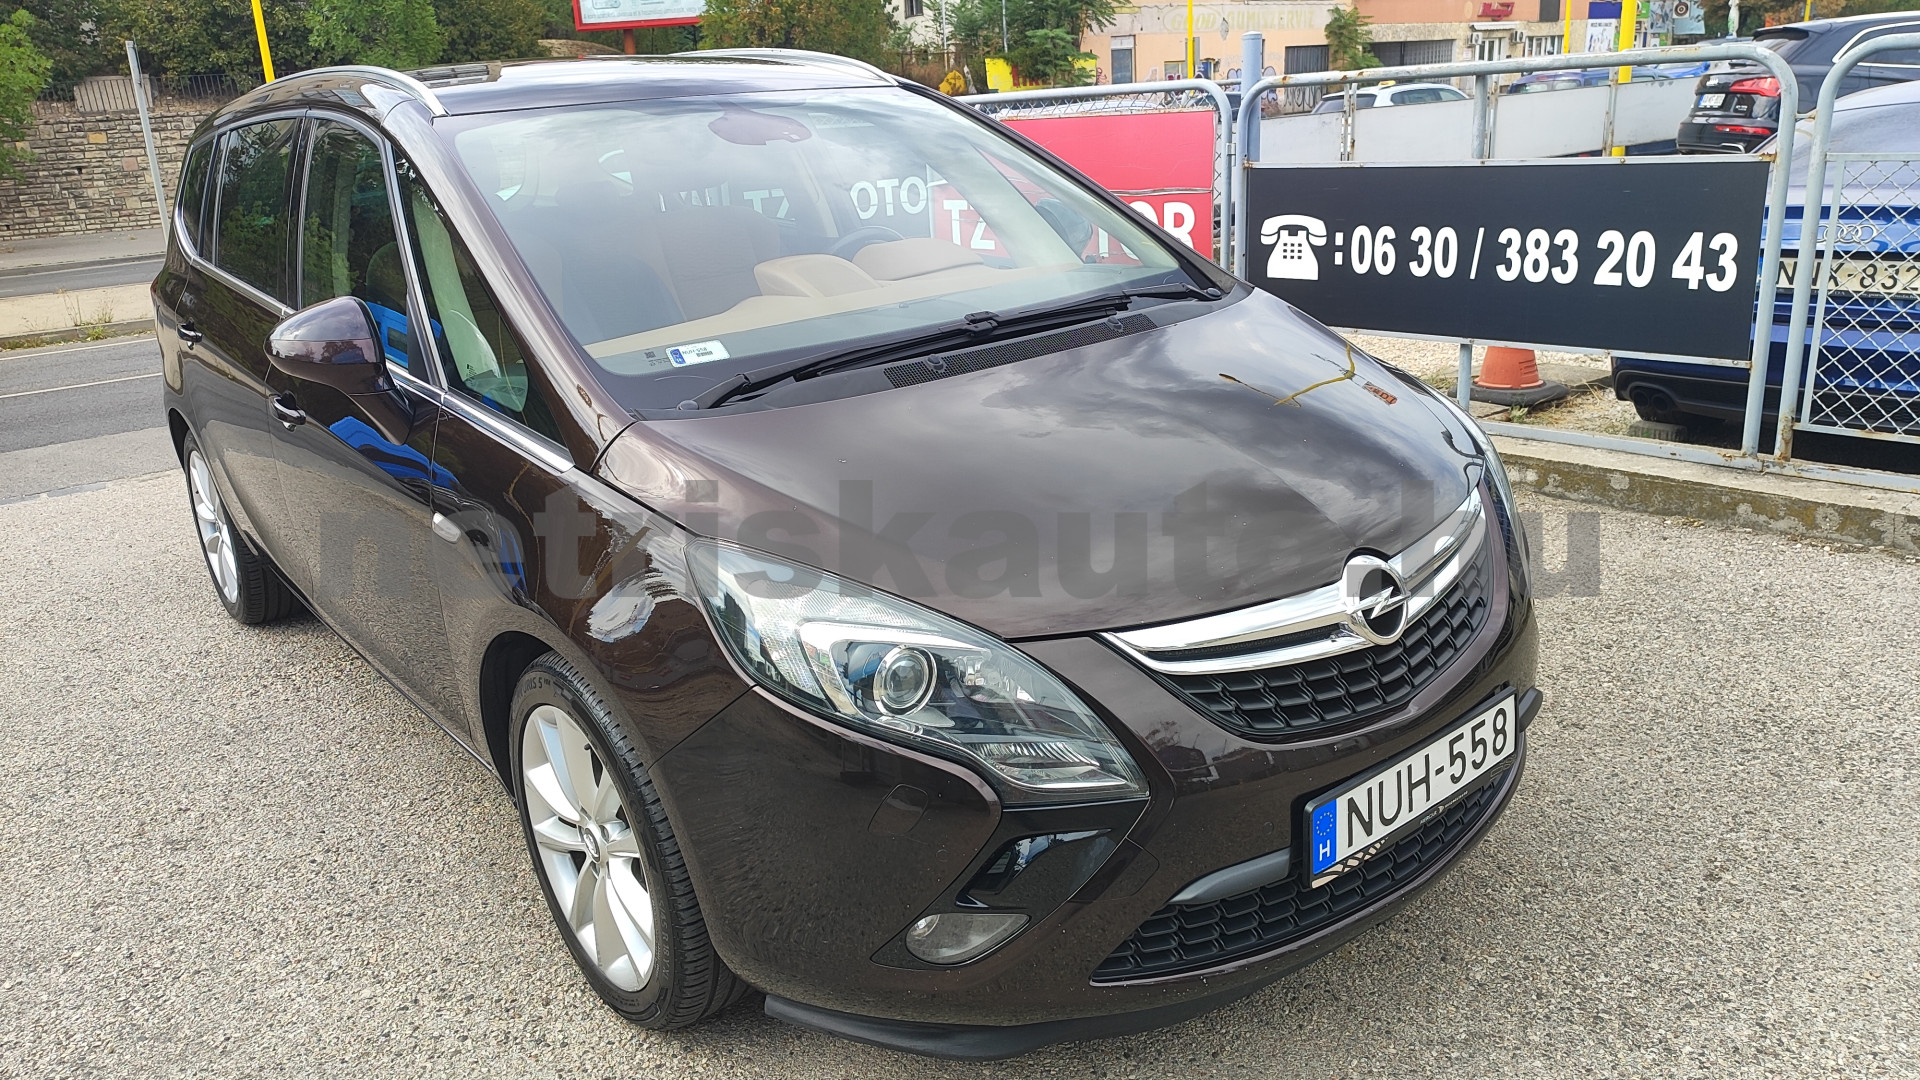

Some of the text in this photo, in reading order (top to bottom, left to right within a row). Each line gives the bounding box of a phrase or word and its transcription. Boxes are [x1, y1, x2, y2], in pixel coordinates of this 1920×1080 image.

[1409, 226, 1458, 279] 30
[1470, 227, 1484, 279] /
[1496, 227, 1579, 284] 383
[1593, 230, 1656, 288] 20
[1672, 232, 1738, 292] 43
[1319, 707, 1508, 861] H NUH-558
